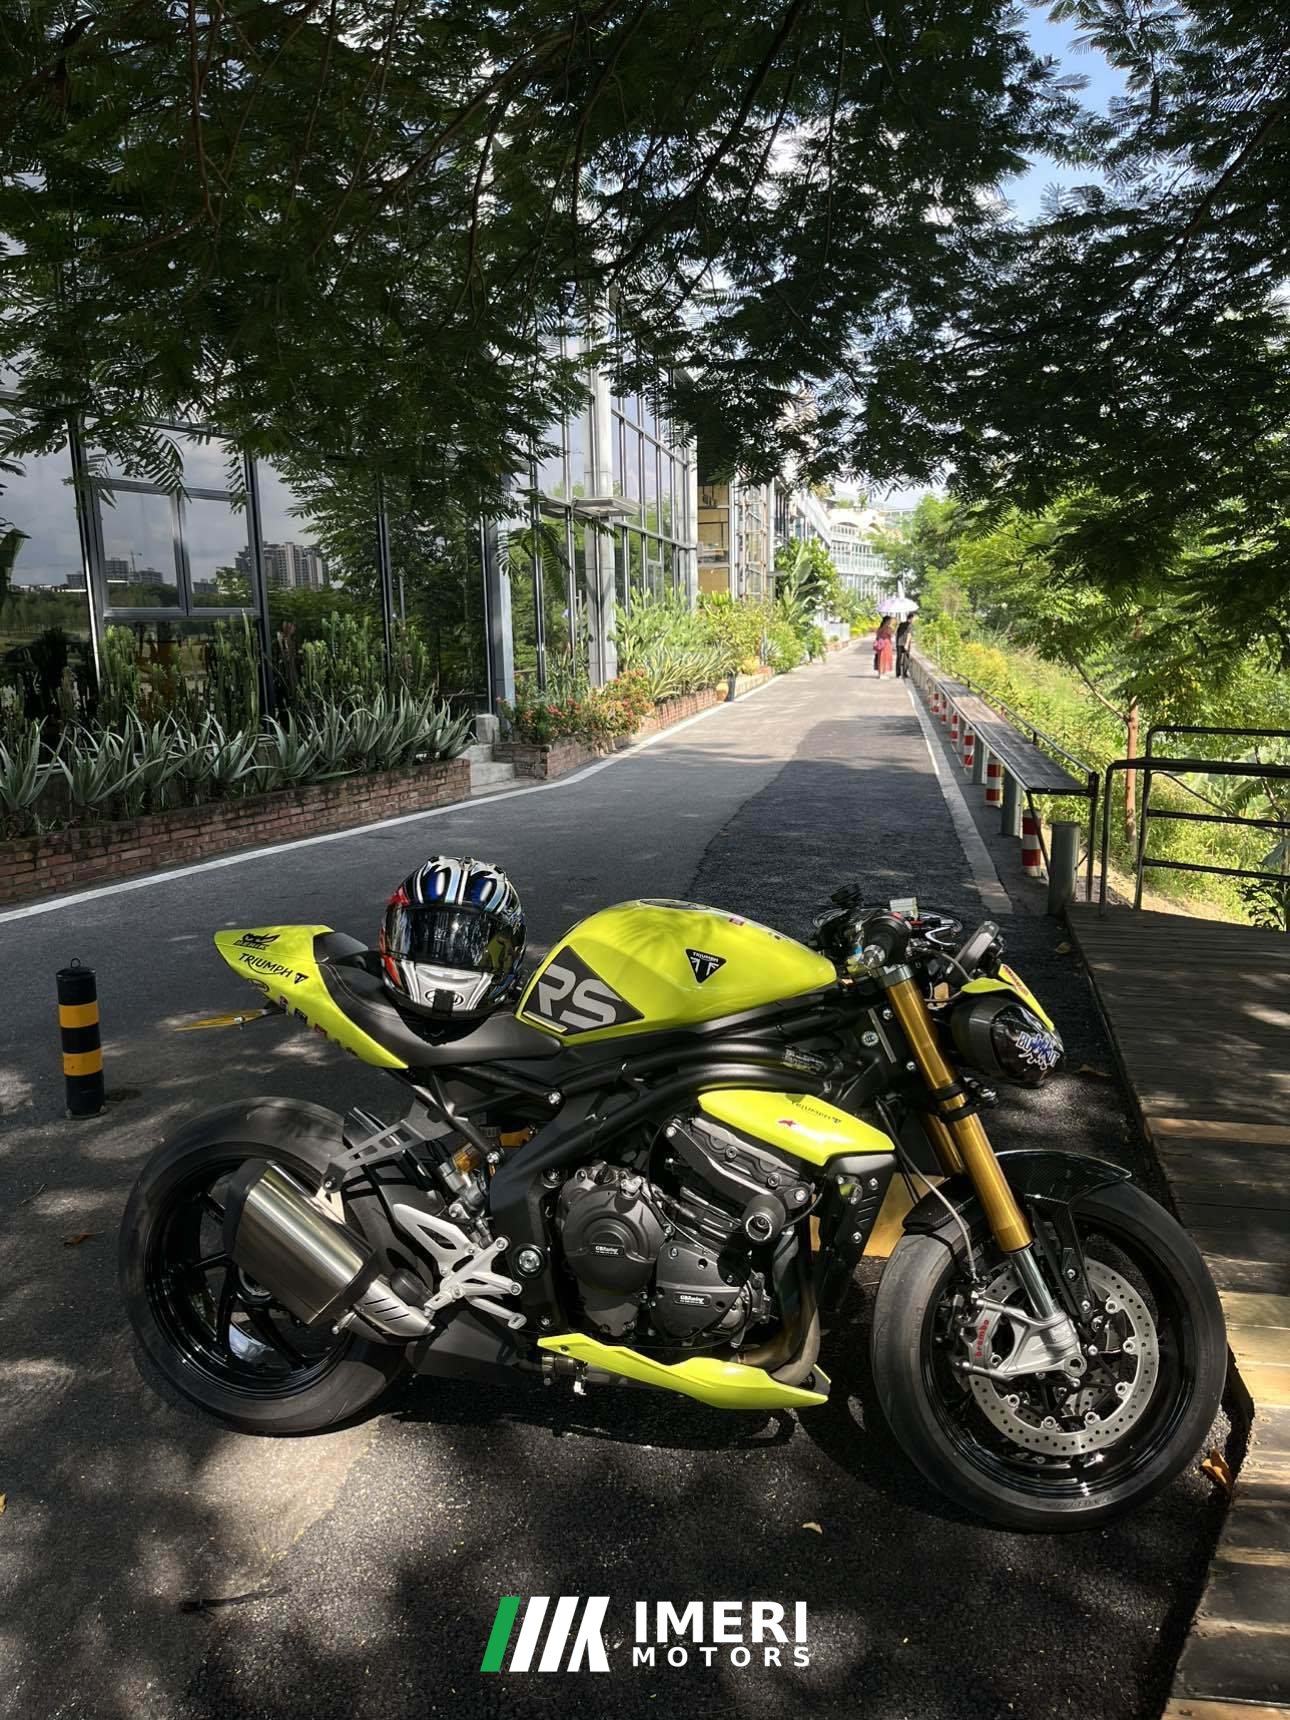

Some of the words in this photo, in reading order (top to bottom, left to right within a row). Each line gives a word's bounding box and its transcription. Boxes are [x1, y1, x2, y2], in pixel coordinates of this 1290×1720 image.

[239, 952, 294, 978] TRIUMPH
[537, 963, 623, 1030] RS
[975, 1318, 990, 1358] brembo
